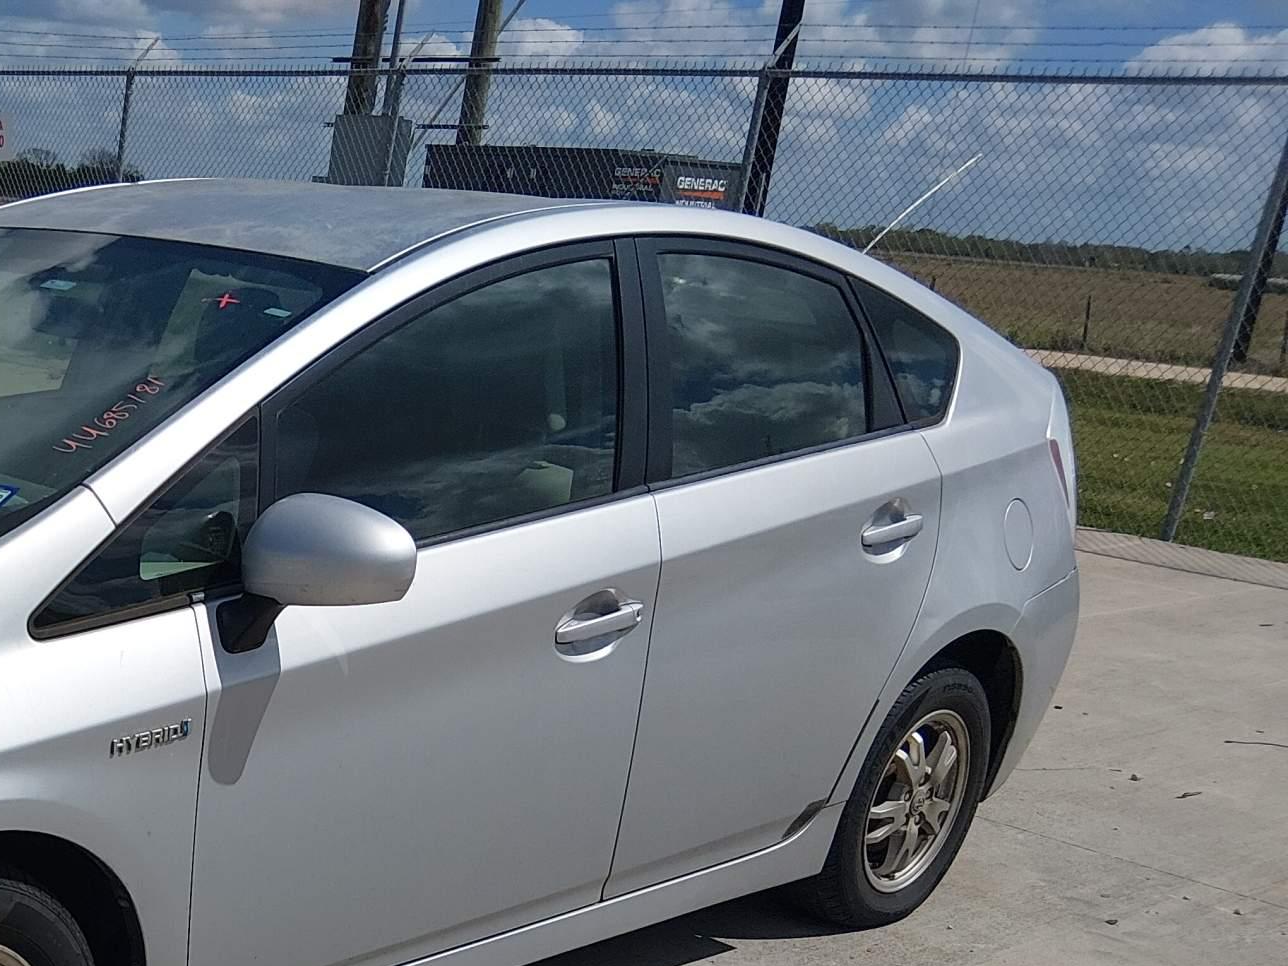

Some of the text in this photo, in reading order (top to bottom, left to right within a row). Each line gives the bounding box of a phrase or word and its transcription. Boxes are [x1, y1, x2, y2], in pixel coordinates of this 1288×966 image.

[676, 176, 726, 191] GENERAC
[53, 374, 165, 454] 44685181
[109, 723, 181, 759] HYBRID
